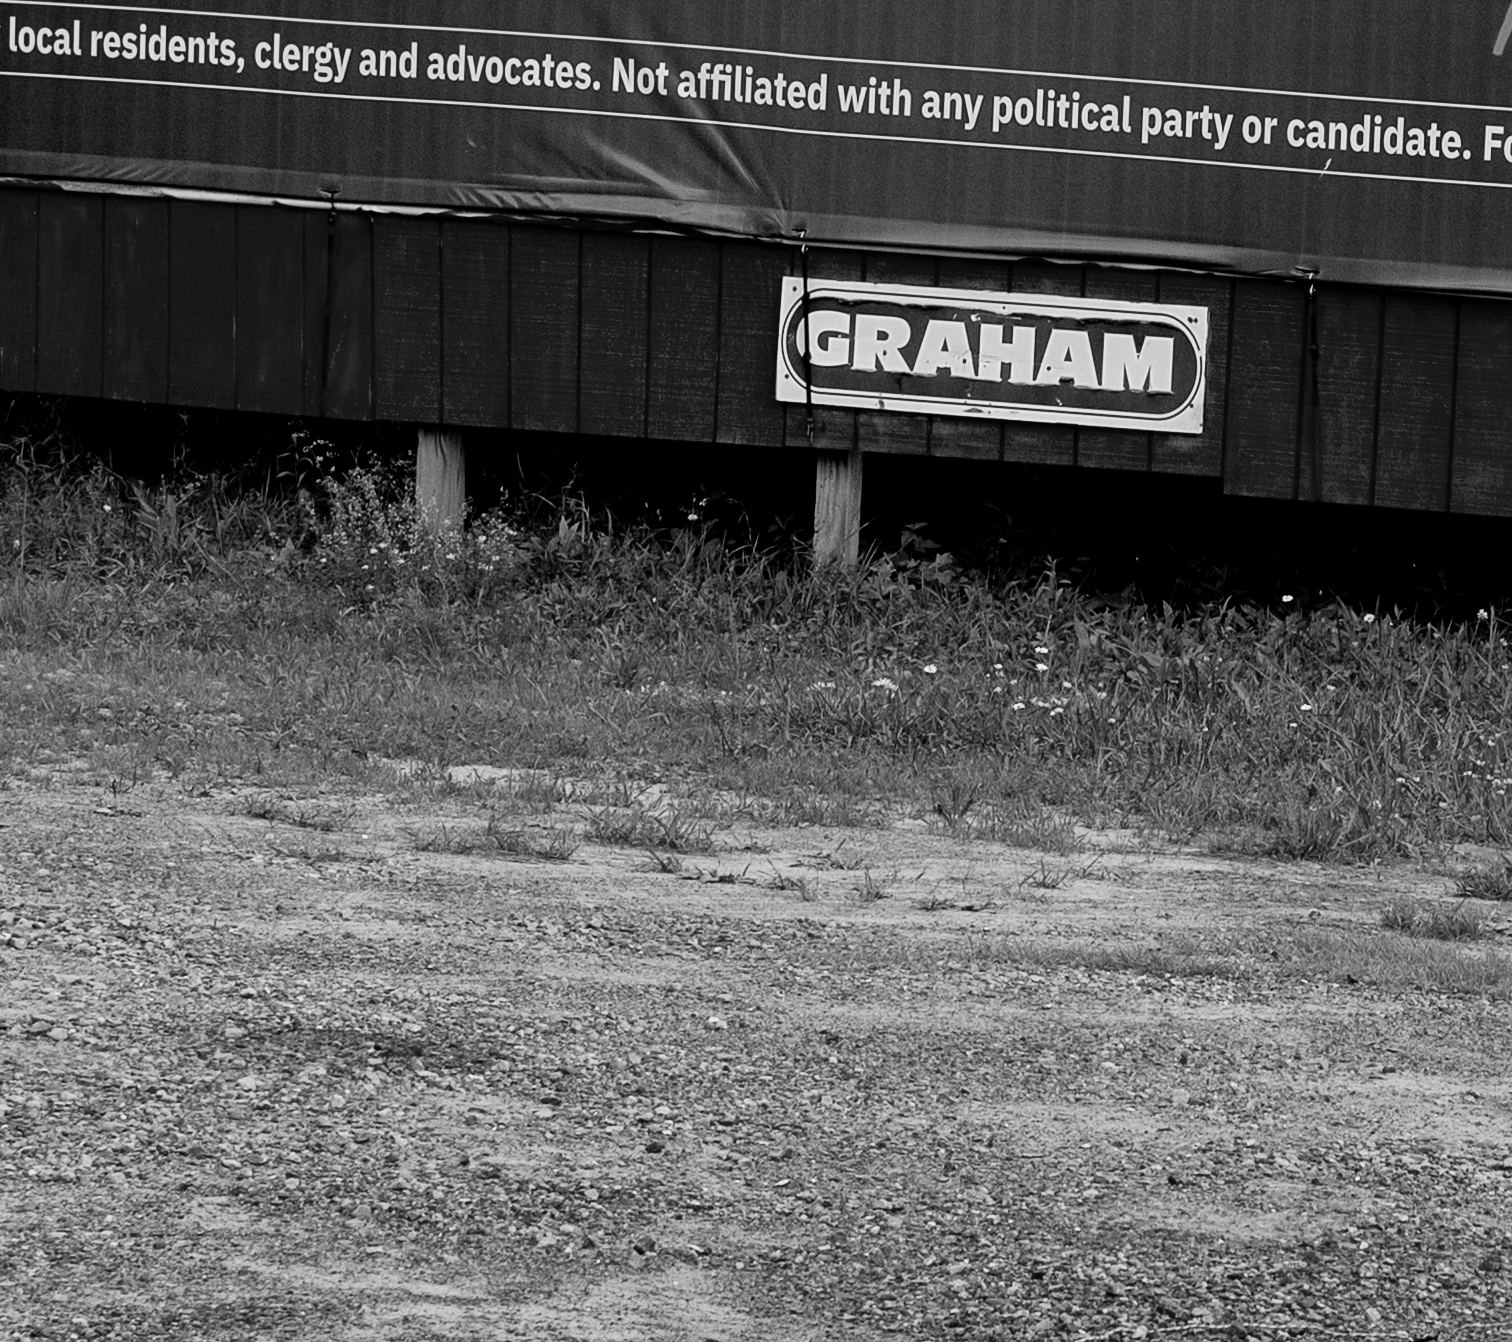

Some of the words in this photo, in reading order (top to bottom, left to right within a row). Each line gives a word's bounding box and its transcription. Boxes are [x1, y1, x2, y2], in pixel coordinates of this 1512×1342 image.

[9, 15, 81, 55] local
[91, 23, 244, 75] residents,
[255, 33, 351, 84] clergy
[359, 39, 417, 78] and
[427, 45, 600, 90] advocates.
[613, 56, 669, 94] Not
[678, 61, 827, 110] affiliated
[838, 74, 911, 116] with
[922, 88, 984, 130] any
[993, 86, 1131, 132] political
[1142, 103, 1233, 149] party
[1243, 113, 1277, 144] or
[1287, 112, 1471, 159] candidate.
[796, 310, 1175, 395] GRAHAM
